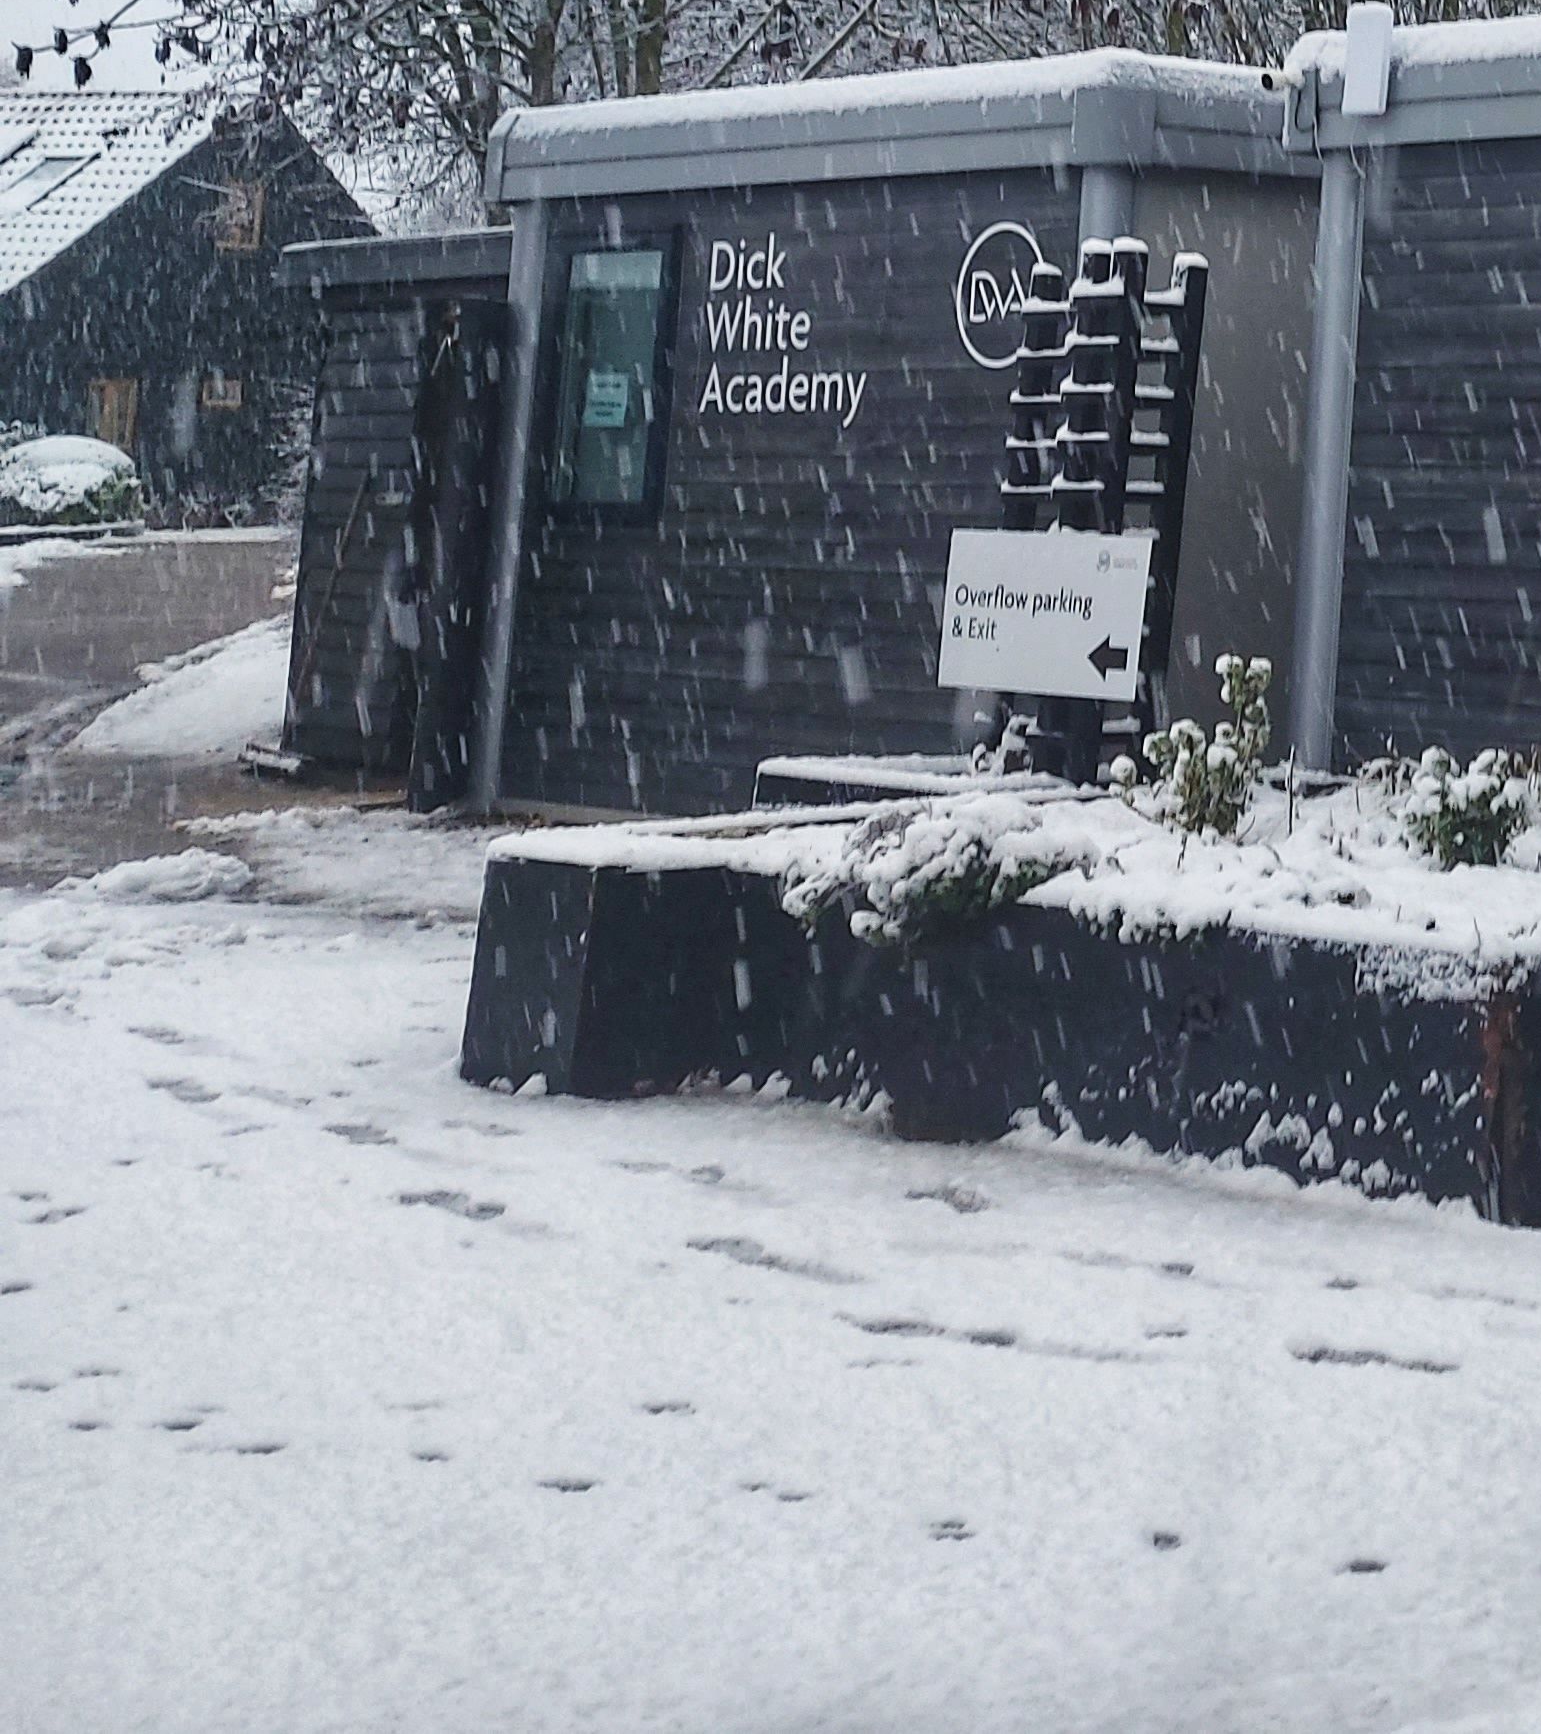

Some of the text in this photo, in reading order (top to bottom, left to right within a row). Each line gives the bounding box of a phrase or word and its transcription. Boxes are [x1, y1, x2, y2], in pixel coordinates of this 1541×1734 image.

[710, 232, 786, 291] Dick
[706, 294, 811, 353] White
[699, 355, 867, 429] Academy
[952, 615, 997, 641] & Exit
[955, 584, 1092, 621] Overflow parking
